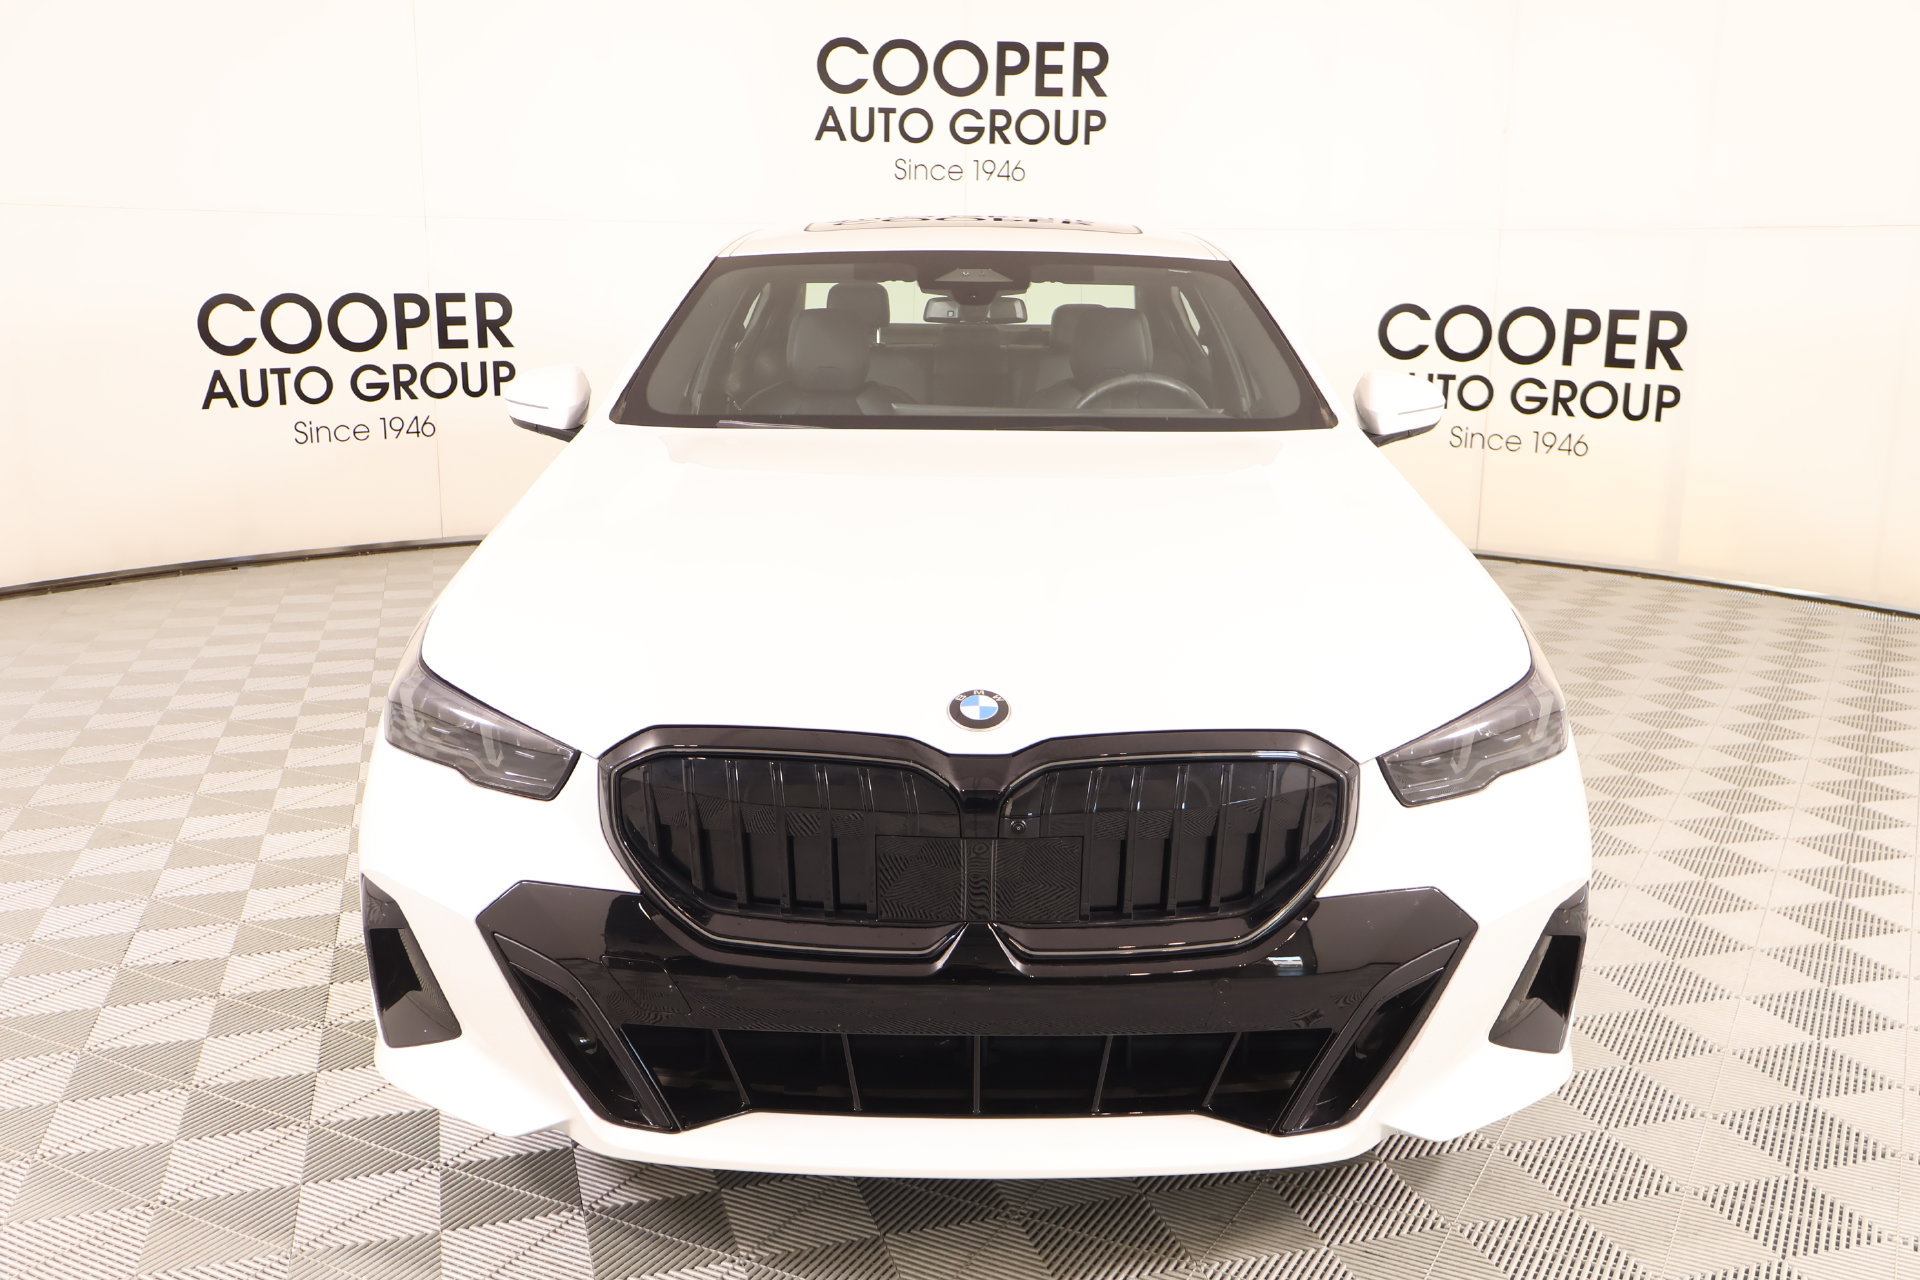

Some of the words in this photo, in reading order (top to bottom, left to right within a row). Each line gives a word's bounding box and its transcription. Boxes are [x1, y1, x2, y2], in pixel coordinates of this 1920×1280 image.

[816, 37, 1109, 97] COOPER
[814, 106, 934, 144] AUTO
[949, 108, 1107, 146] GROUP
[894, 158, 963, 181] Since
[973, 160, 1026, 181] 1946
[197, 292, 515, 356] COOPER
[1378, 303, 1688, 371] COOPER
[201, 366, 333, 410] AUTO
[350, 360, 516, 402] GROUP
[1409, 372, 1494, 411] TO
[1510, 377, 1681, 422] GROUP
[294, 420, 370, 444] Since
[379, 415, 436, 440] 1946
[1449, 425, 1522, 452] Since
[1533, 431, 1589, 457] 1946
